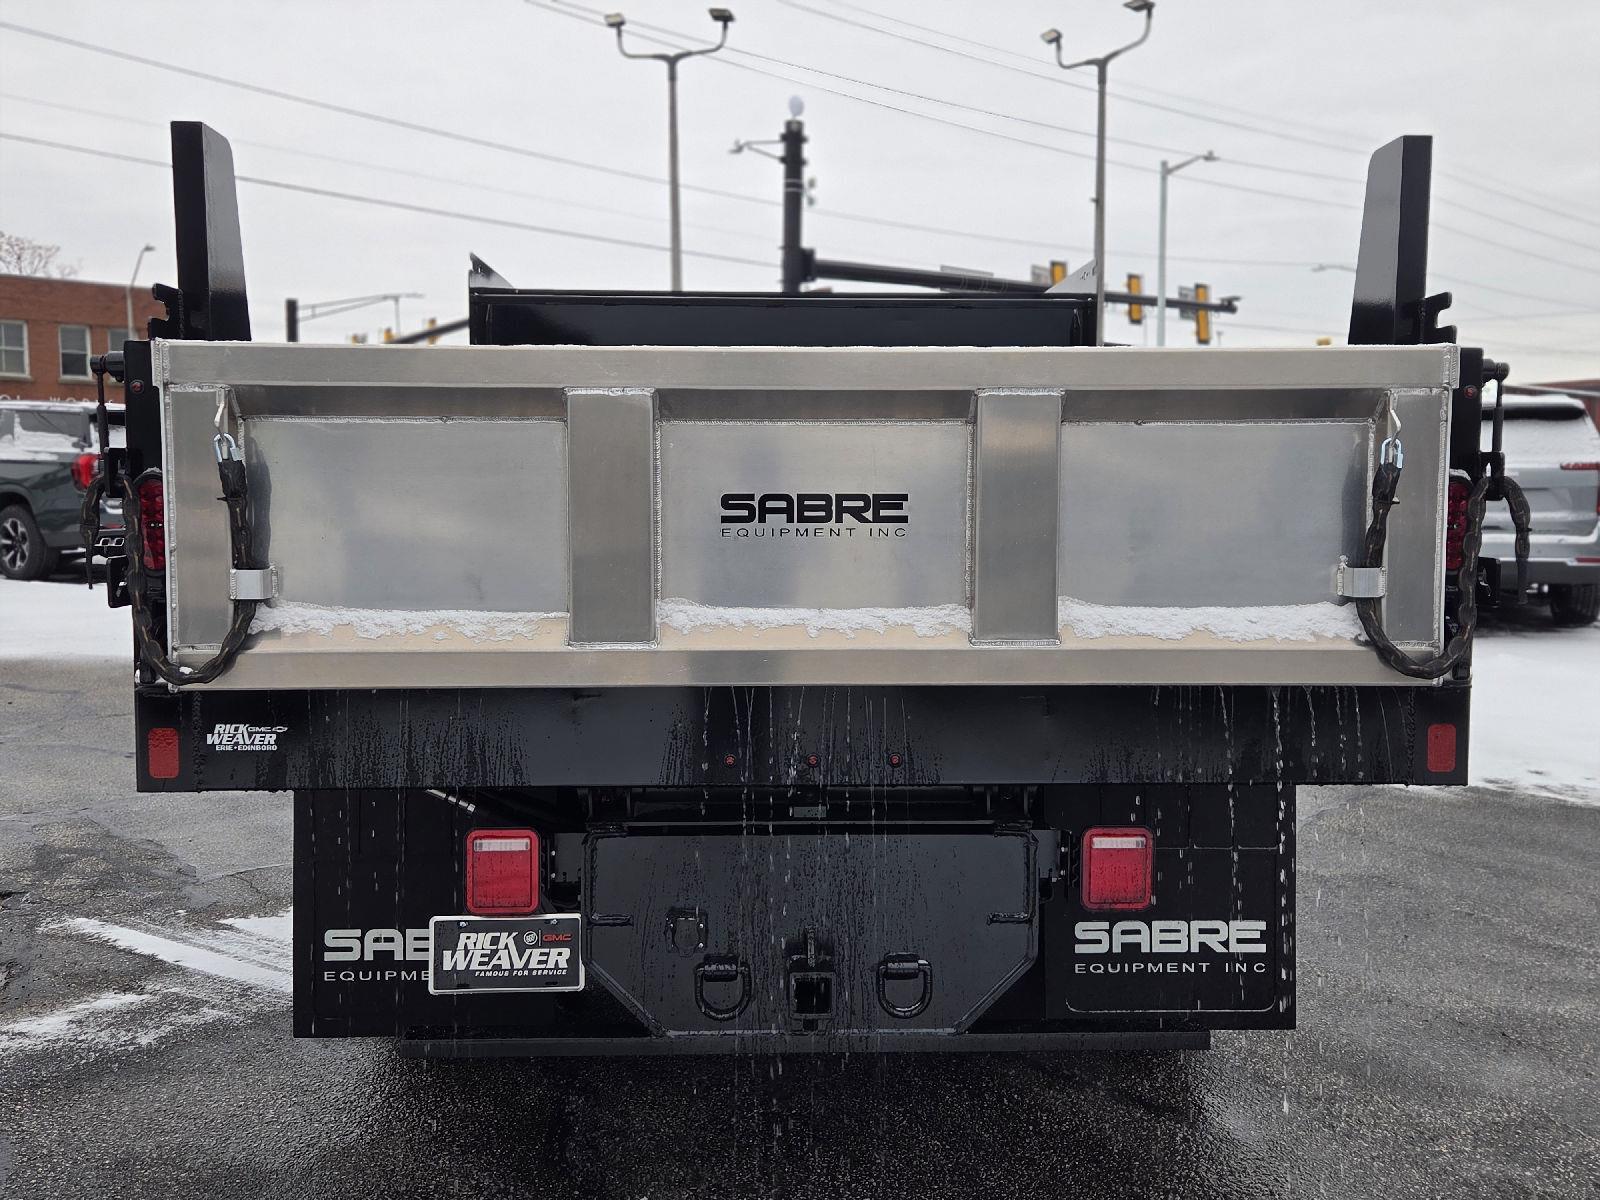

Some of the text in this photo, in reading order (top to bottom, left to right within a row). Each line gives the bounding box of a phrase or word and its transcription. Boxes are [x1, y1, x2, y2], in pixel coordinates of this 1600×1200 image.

[720, 493, 909, 524] SABRE
[720, 527, 906, 538] EQUIPMENT INC
[214, 723, 249, 734] RICK
[206, 733, 277, 745] WEAVER
[456, 932, 572, 950] RICK GMC
[1074, 920, 1267, 954] SABRE
[442, 947, 571, 971] WEAVER
[1074, 962, 1266, 974] EQUIPMENT INC
